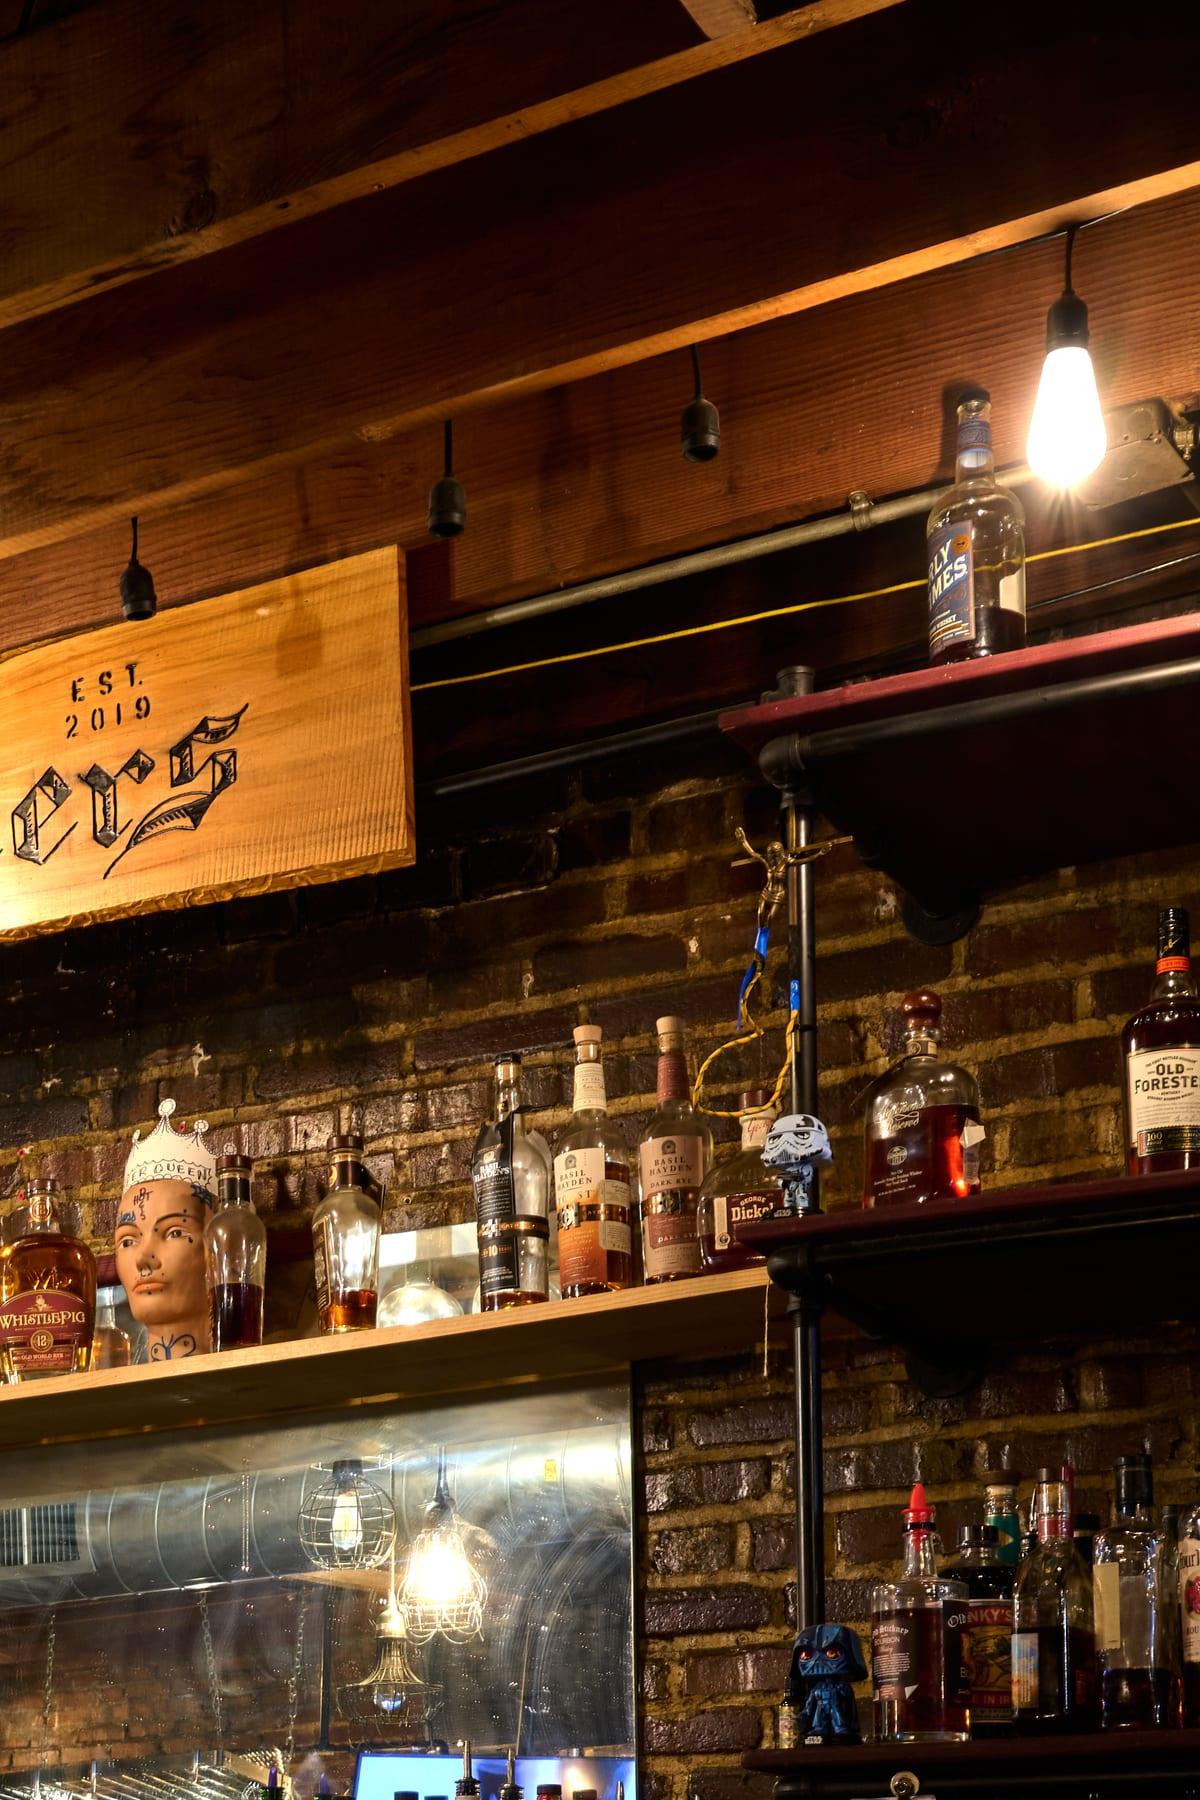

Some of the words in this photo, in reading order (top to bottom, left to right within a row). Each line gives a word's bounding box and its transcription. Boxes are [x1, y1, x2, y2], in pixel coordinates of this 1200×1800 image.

[70, 663, 143, 703] EST.
[64, 695, 152, 739] 2019
[1156, 1063, 1185, 1076] OLD
[1134, 1075, 1199, 1095] FORESTE
[1146, 1131, 1163, 1142] 100
[653, 1156, 686, 1166] BASIL
[153, 1162, 208, 1181] QUEEN
[559, 1169, 586, 1182] BASIL
[649, 1165, 693, 1175] HAYDEN
[557, 1177, 593, 1191] HAYDEN
[649, 1180, 672, 1188] DARK
[731, 1202, 775, 1222] Dicke
[488, 1244, 497, 1256] 10
[36, 1335, 48, 1347] 12
